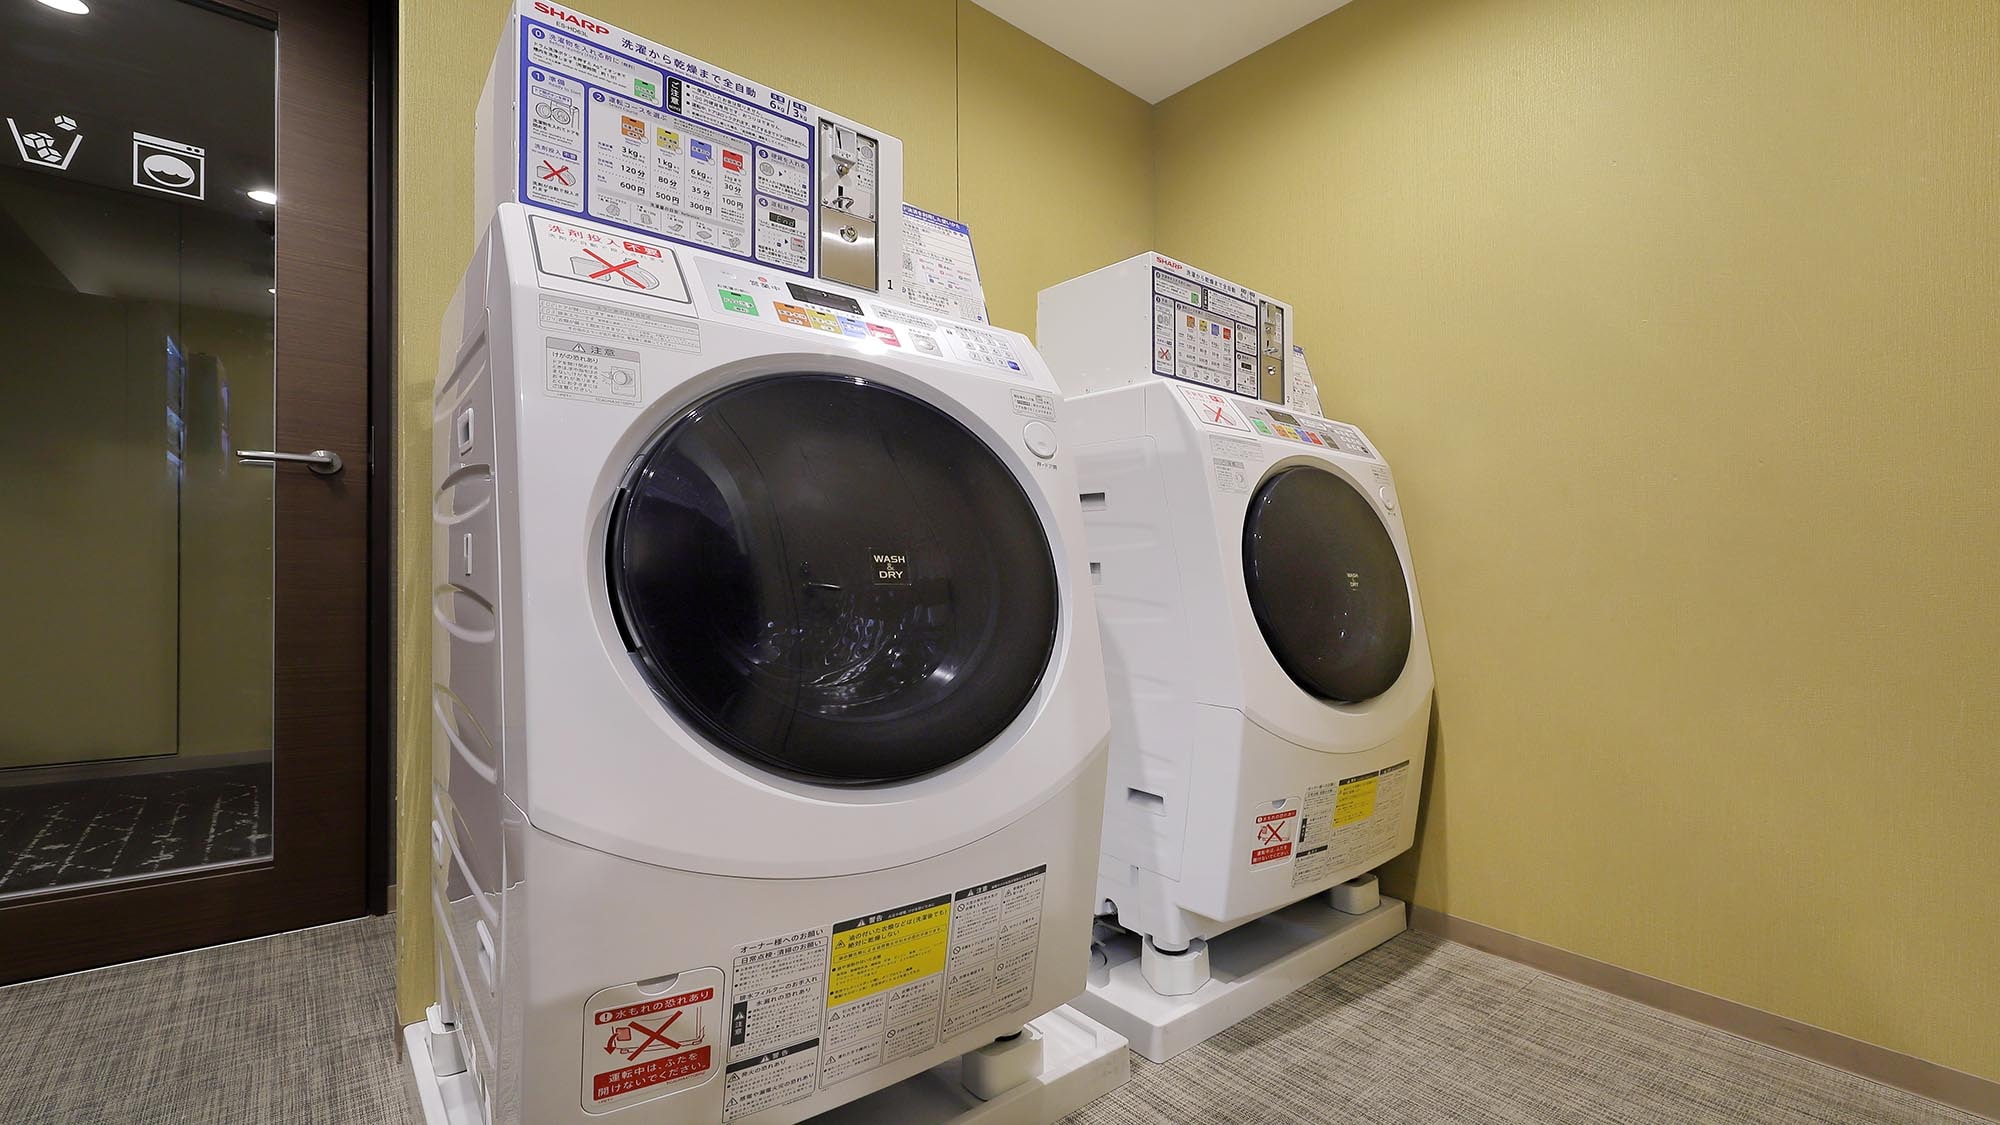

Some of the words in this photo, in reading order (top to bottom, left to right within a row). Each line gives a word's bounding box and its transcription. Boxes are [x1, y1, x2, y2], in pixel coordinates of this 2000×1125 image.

[535, 2, 609, 35] SHARP
[549, 34, 620, 64] 洗濯物を入れる前に
[621, 37, 756, 98] 洗濯から乾燥まで全自動
[549, 75, 565, 86] 準備
[670, 80, 681, 105] ご注意
[608, 97, 667, 121] 運転コースを選ぶ
[771, 153, 806, 168] 硬貨を入れる
[619, 181, 646, 194] 600円
[655, 191, 680, 204] 500円
[722, 197, 743, 209] 100円
[689, 201, 712, 213] 300円
[772, 201, 794, 212] 運転終了
[548, 224, 622, 248] 洗剤投入
[1156, 256, 1183, 270] SHARP
[887, 280, 893, 290] 1
[552, 352, 599, 364] けがの恐れあり
[590, 345, 616, 357] 注意
[873, 554, 906, 563] WASH
[879, 570, 903, 579] DRY
[869, 915, 883, 923] 警告
[740, 929, 824, 953] オーナー様へのお願い
[848, 930, 900, 949] 絶対に乾燥しない
[741, 940, 822, 964] 日常点検・清掃のお願い
[615, 990, 709, 1019] 水もれの恐れあり
[609, 1052, 699, 1083] 運転中は、ふたを
[597, 1063, 706, 1097] 開けないでください。
